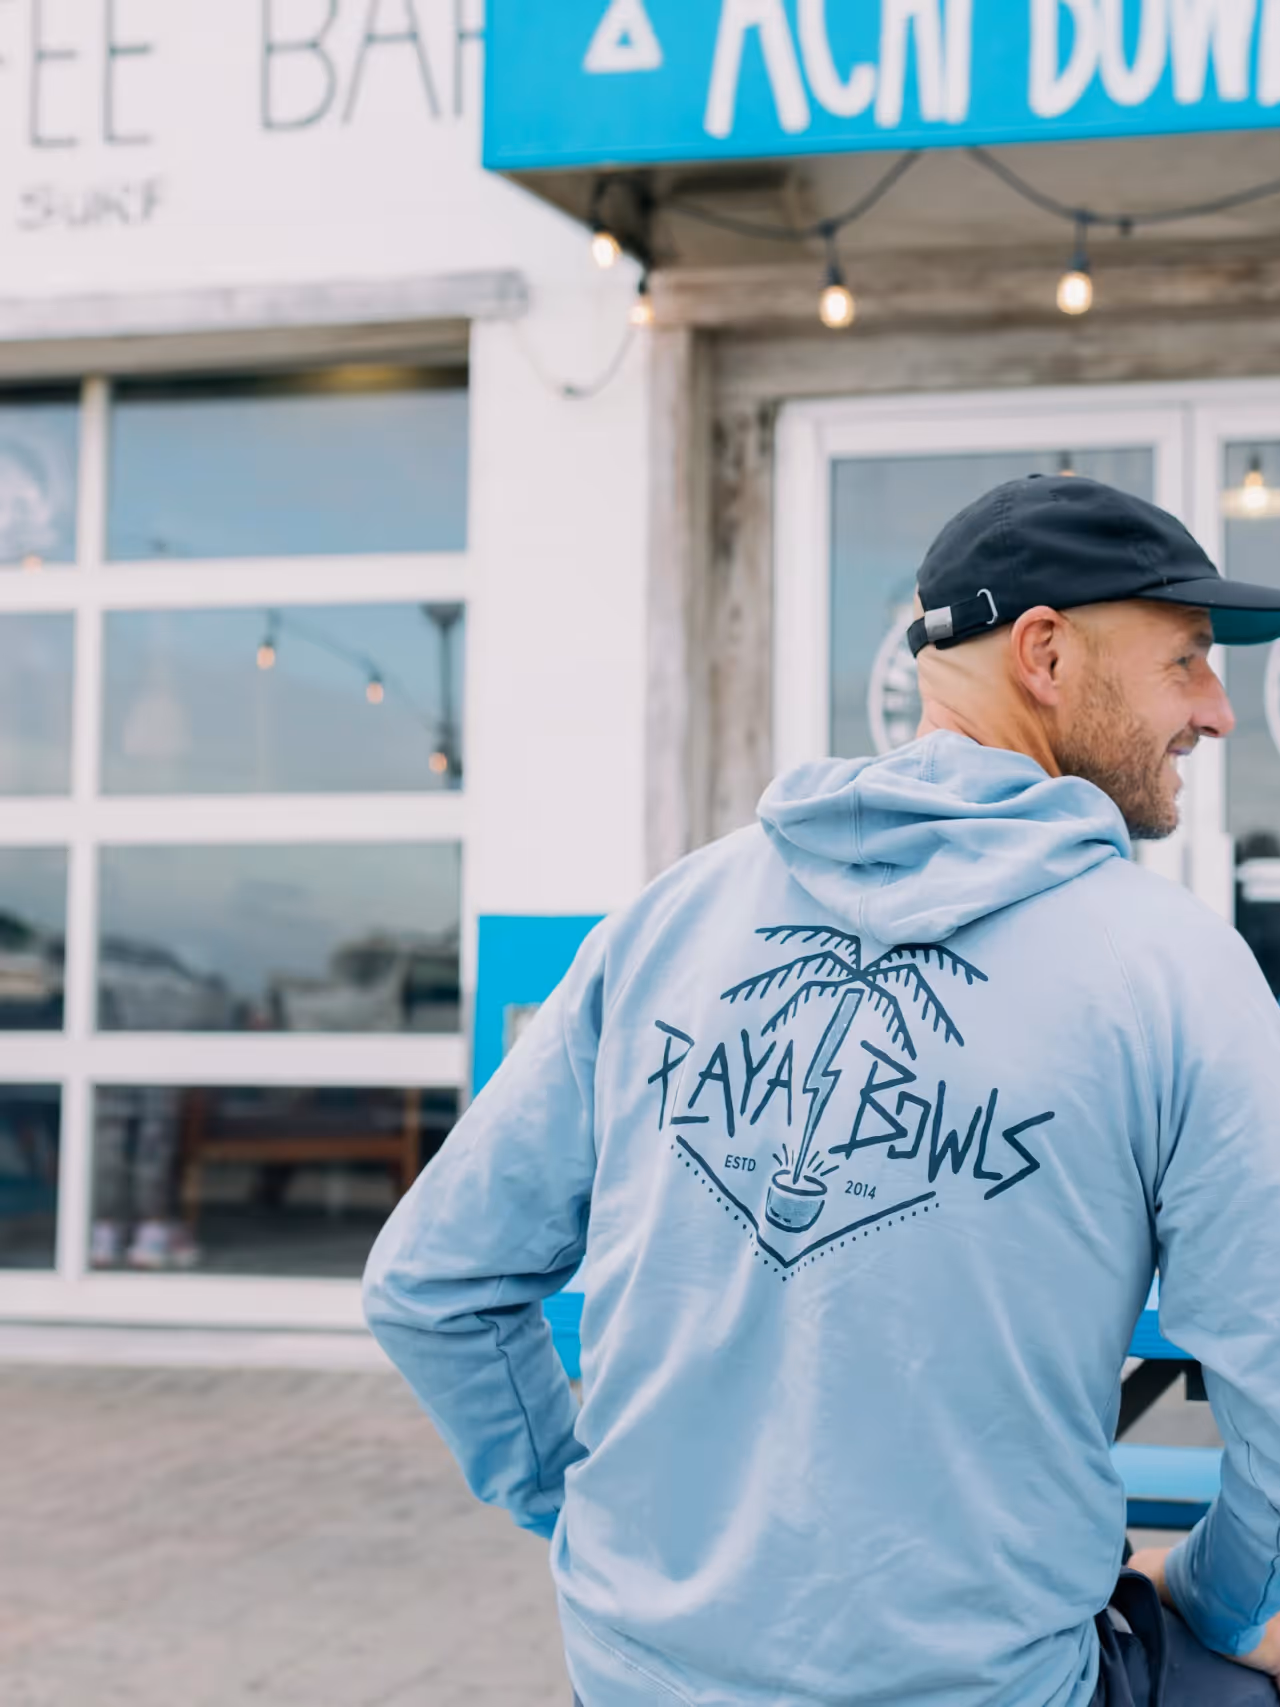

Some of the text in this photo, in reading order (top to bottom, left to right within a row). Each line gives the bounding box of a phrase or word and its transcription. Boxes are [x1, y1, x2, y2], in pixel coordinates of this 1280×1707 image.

[0, 0, 155, 148] EE
[648, 1019, 1055, 1200] PLAYA BOWLS
[724, 1154, 877, 1200] ESTD 2014
